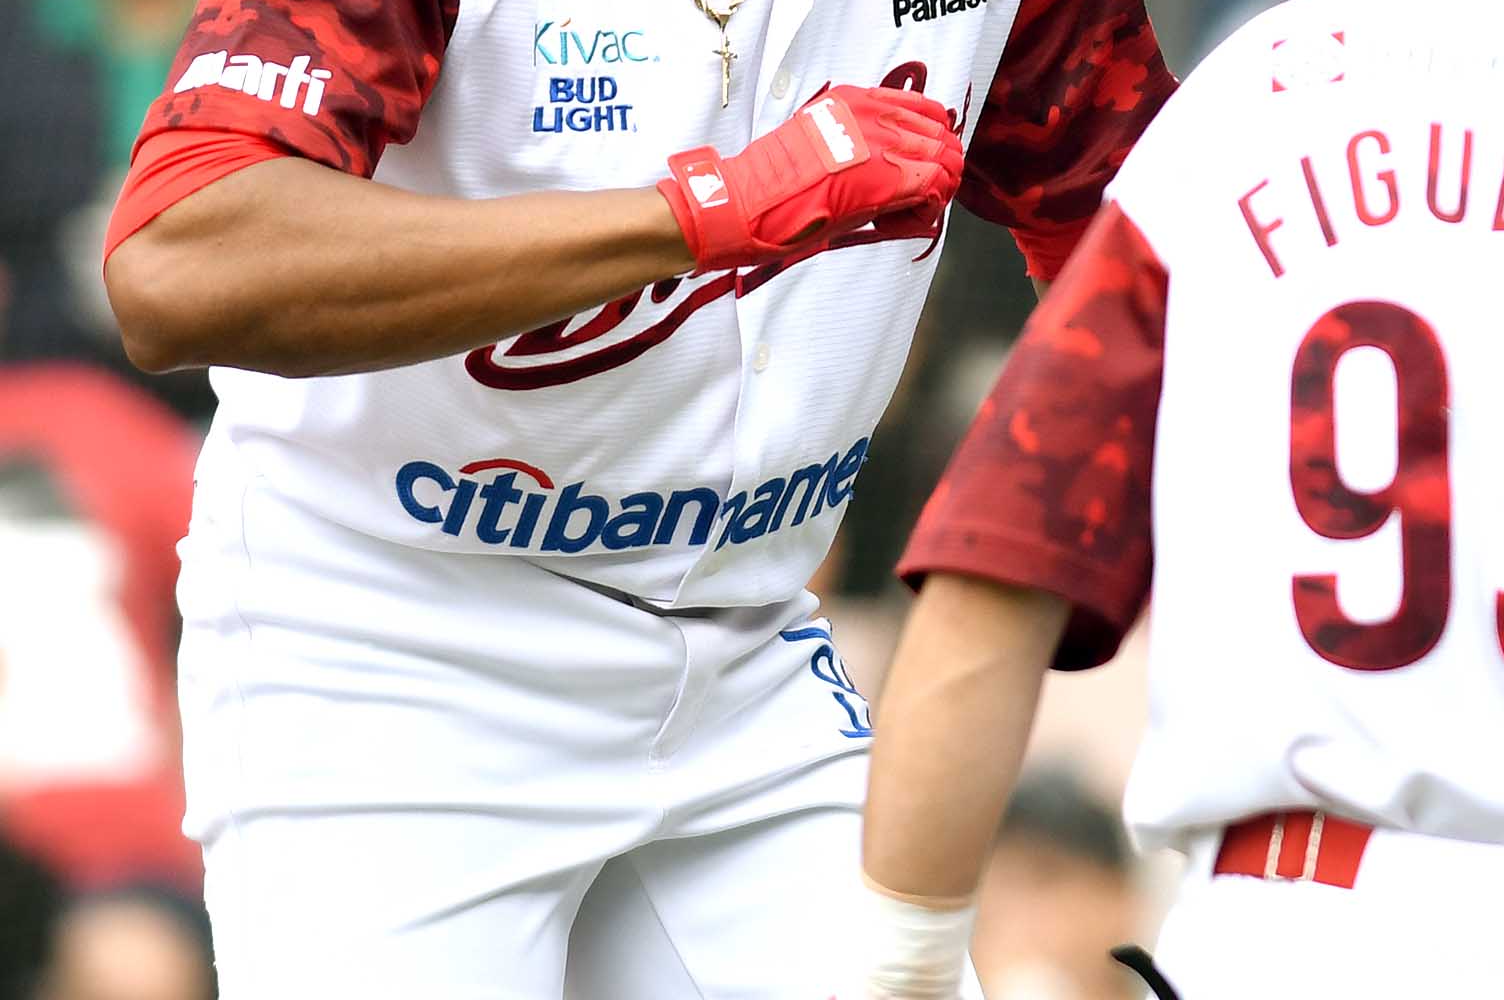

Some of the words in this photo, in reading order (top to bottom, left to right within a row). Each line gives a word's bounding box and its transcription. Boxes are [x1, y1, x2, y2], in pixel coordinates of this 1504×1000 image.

[549, 76, 618, 104] BUD
[532, 104, 634, 134] LIGHT
[395, 436, 870, 554] citibaname
